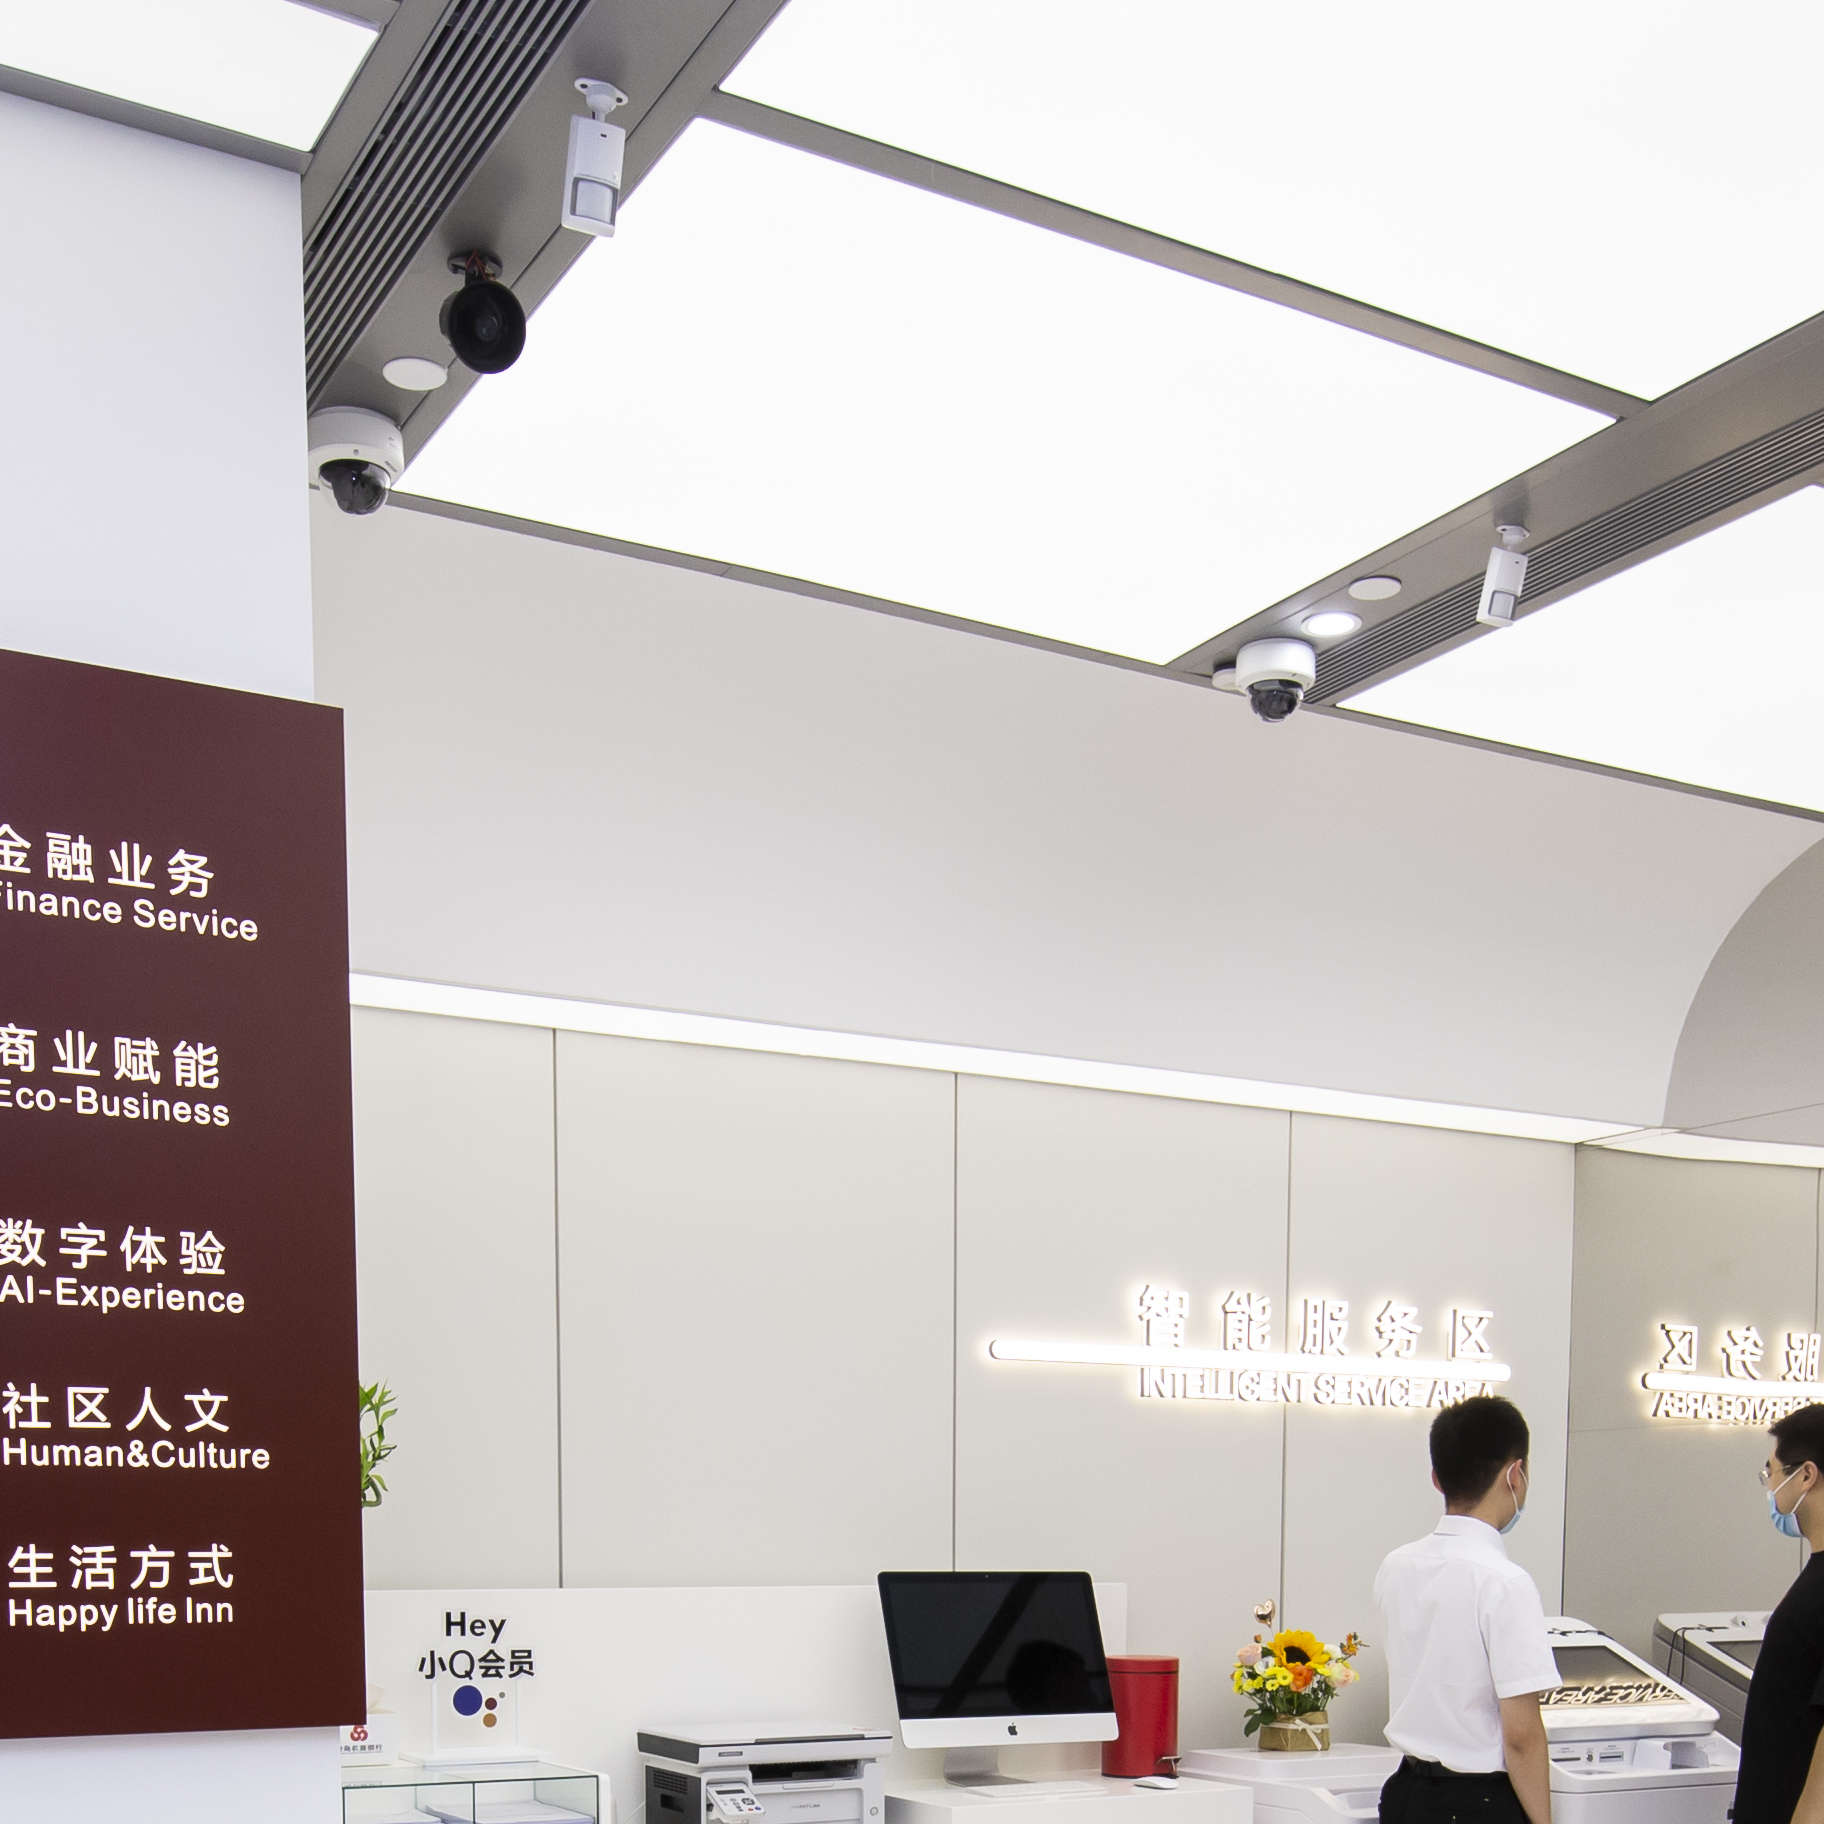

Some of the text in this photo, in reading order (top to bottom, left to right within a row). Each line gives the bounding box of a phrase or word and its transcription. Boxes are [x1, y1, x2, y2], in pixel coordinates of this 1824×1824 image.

[133, 898, 258, 942] Service
[1138, 1284, 1495, 1360] 智能服务区
[2, 1381, 230, 1433] 社区人文
[1140, 1366, 1310, 1403] INTELLIGENT
[1314, 1373, 1423, 1408] SERVICE
[2, 1437, 270, 1470] Human&Culture
[7, 1542, 234, 1590] 生活方式
[8, 1596, 234, 1633] Happy life Inn
[445, 1611, 507, 1644] Hey
[418, 1649, 535, 1681] 小Q会员
